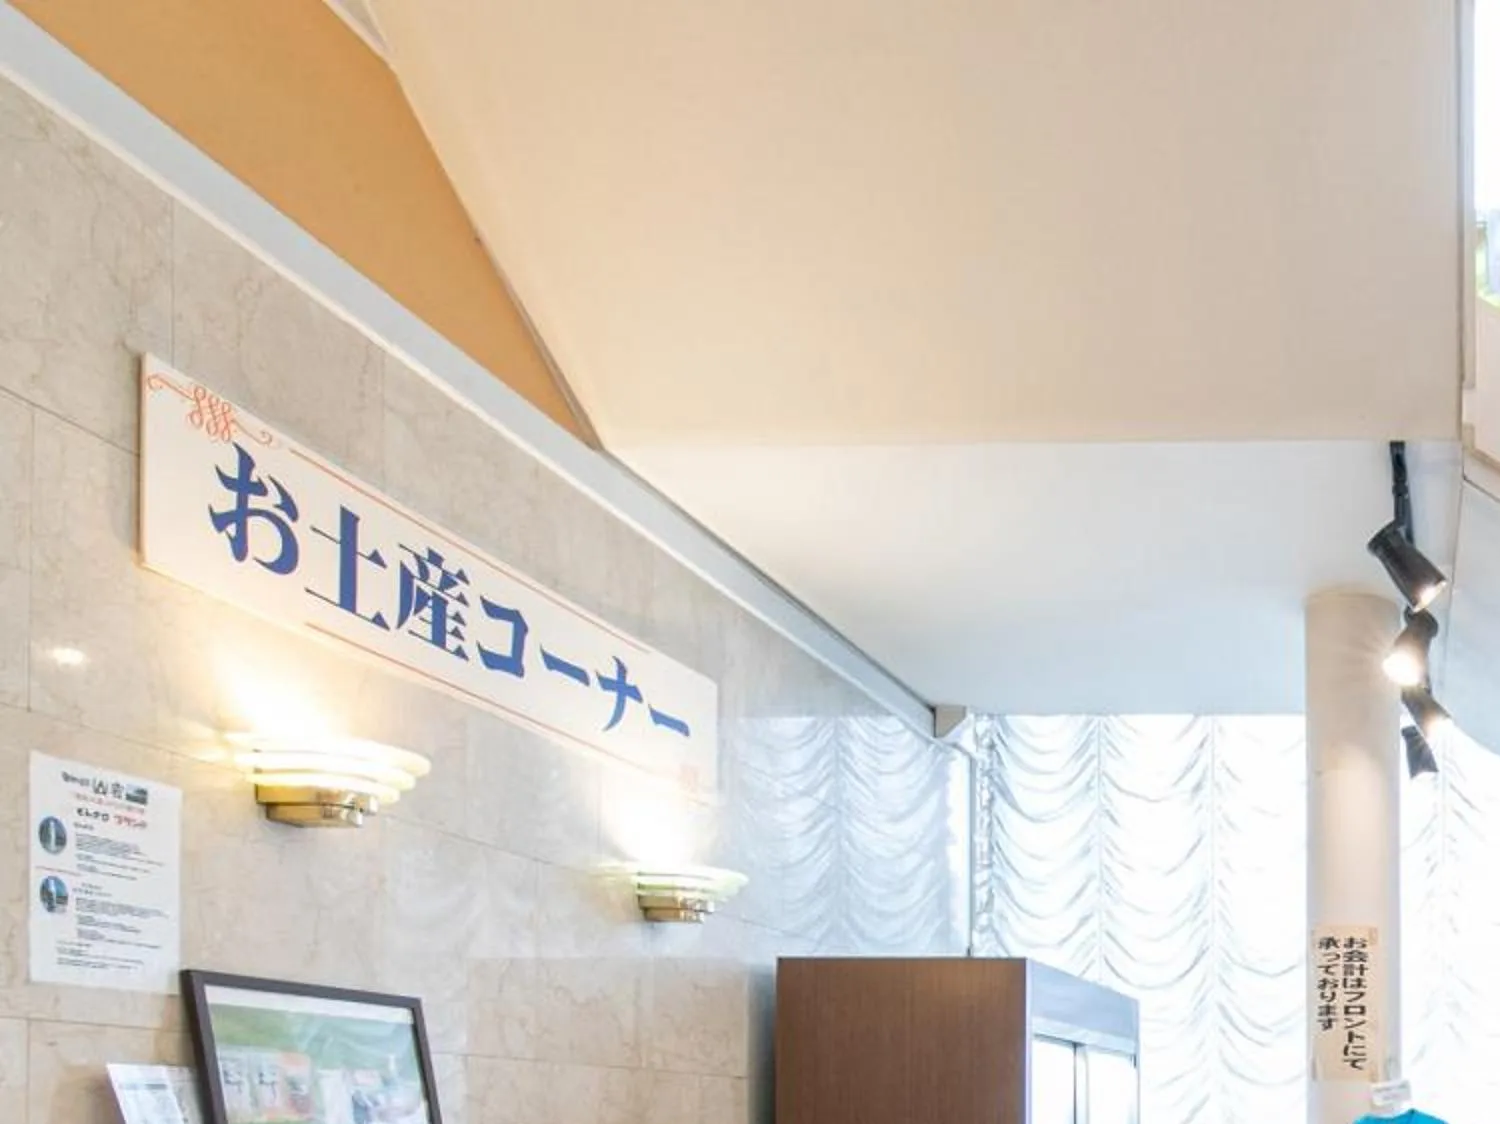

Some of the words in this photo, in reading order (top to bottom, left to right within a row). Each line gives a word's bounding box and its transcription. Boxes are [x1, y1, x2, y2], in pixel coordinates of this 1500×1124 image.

[207, 443, 691, 740] お土産コーナー
[1316, 936, 1341, 1031] 承っております
[1342, 936, 1369, 1071] お会計はフロントにて
